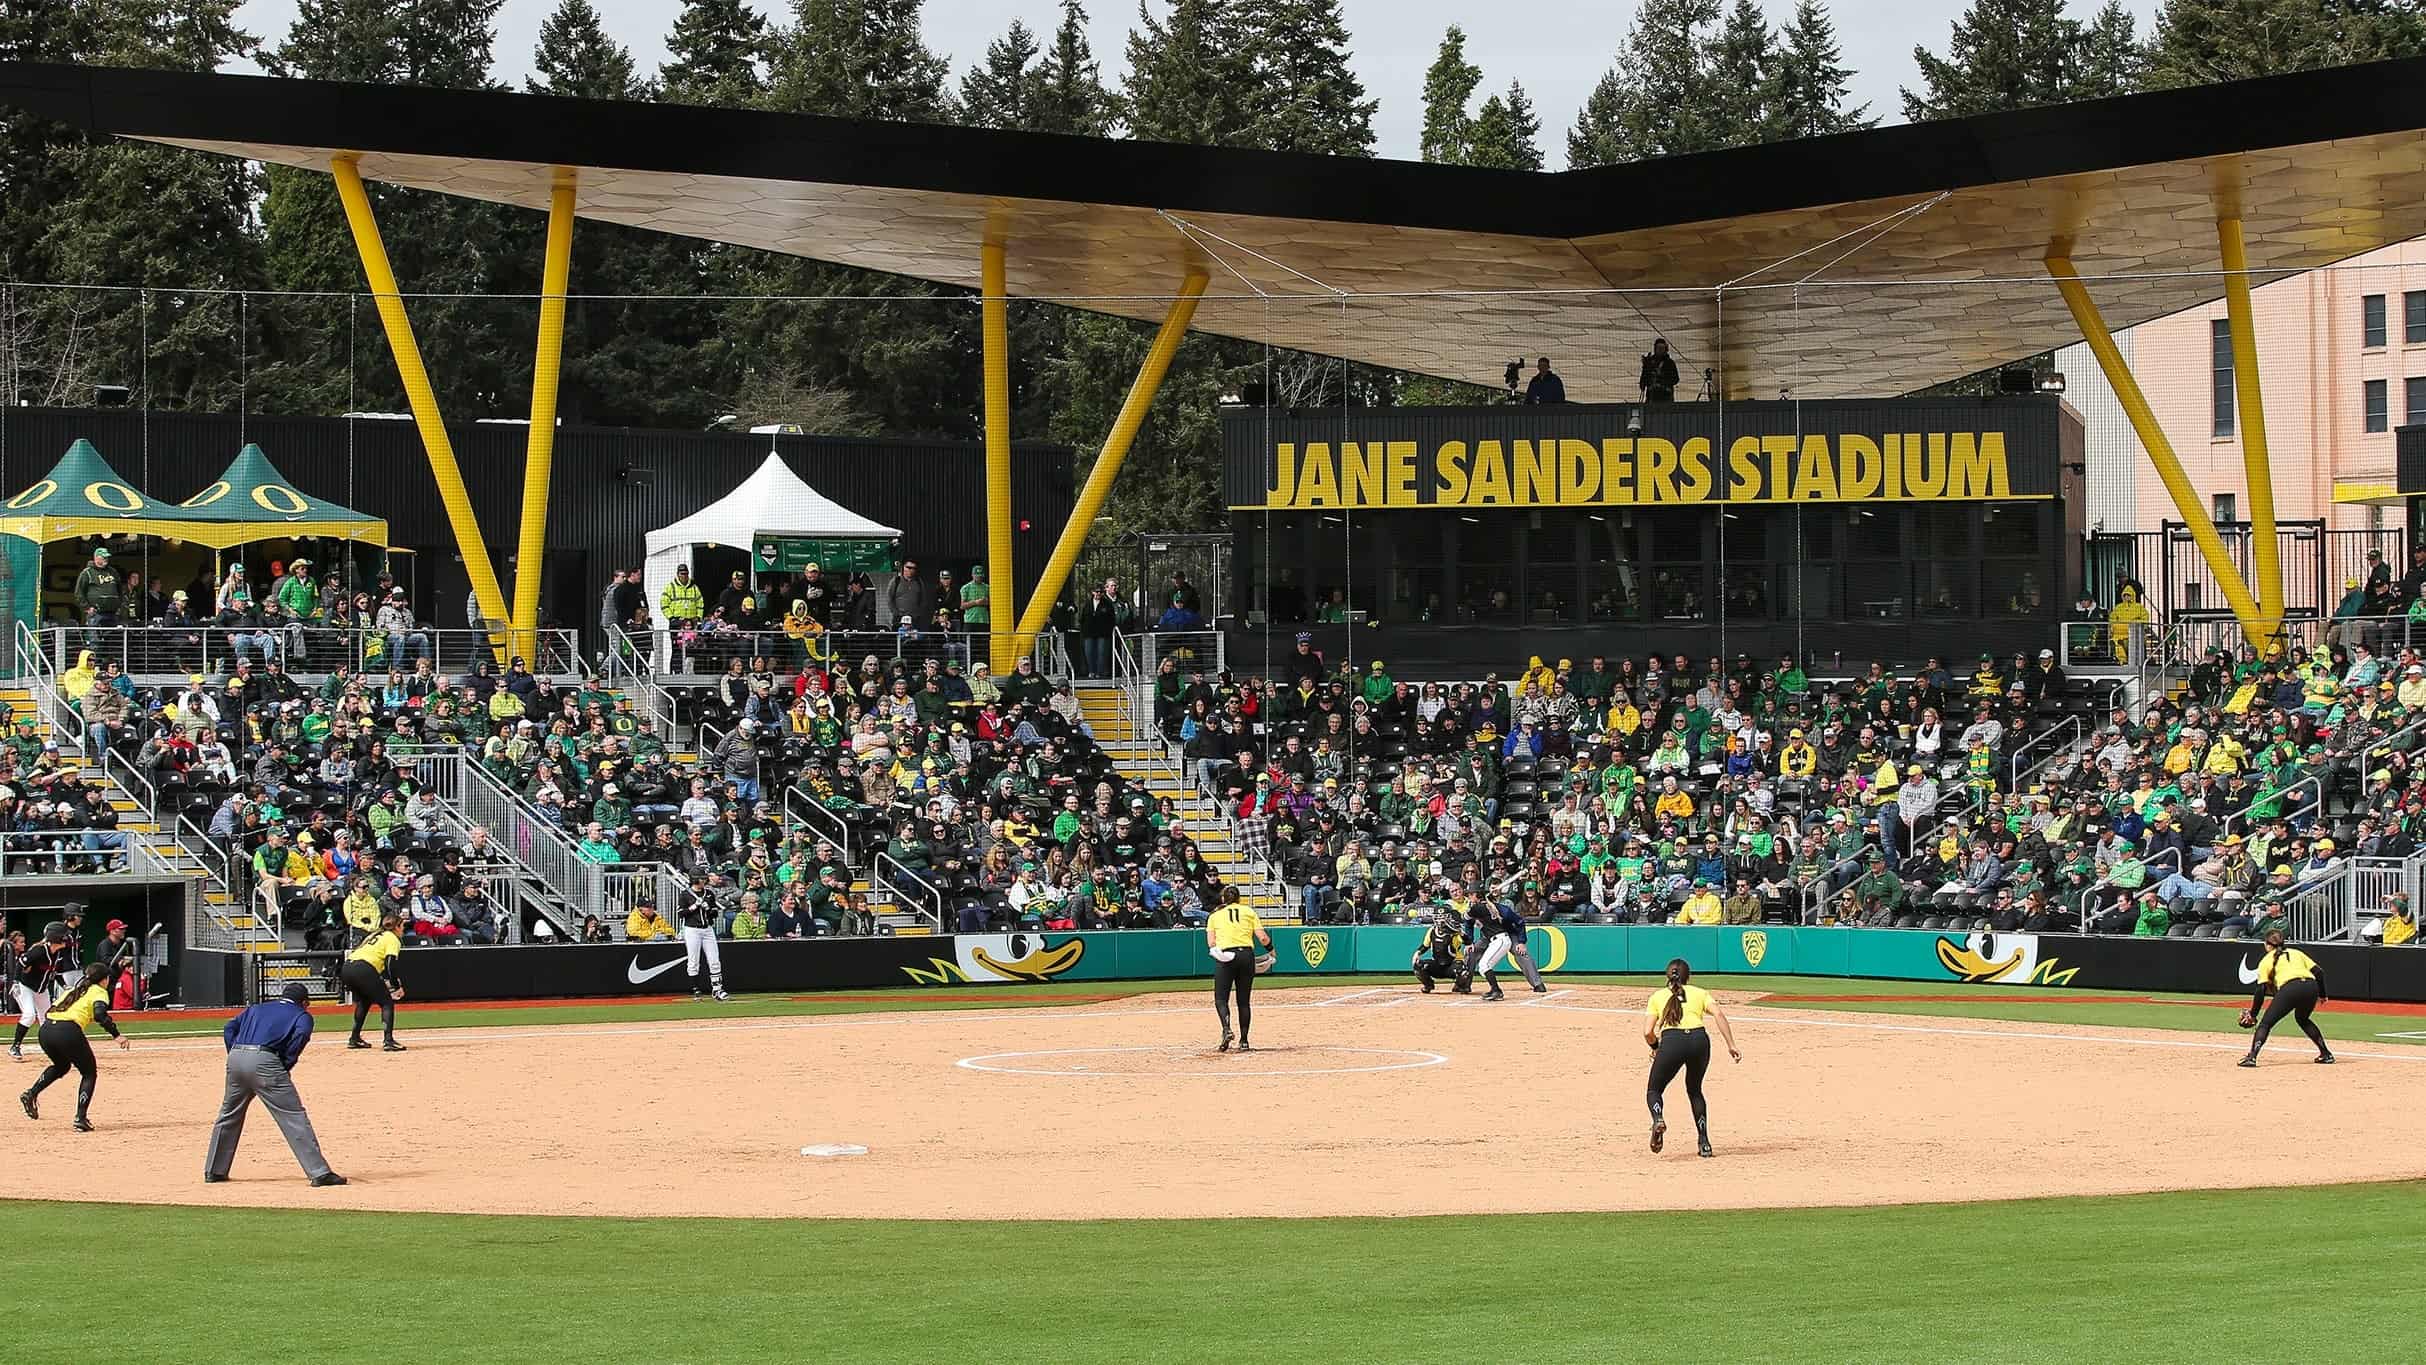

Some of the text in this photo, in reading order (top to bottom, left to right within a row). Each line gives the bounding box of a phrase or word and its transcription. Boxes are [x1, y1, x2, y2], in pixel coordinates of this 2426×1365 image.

[1267, 432, 2010, 506] JANE SANDERS STADIUM
[1228, 908, 1240, 923] 11
[1309, 950, 1321, 961] 12
[1749, 950, 1760, 961] 12
